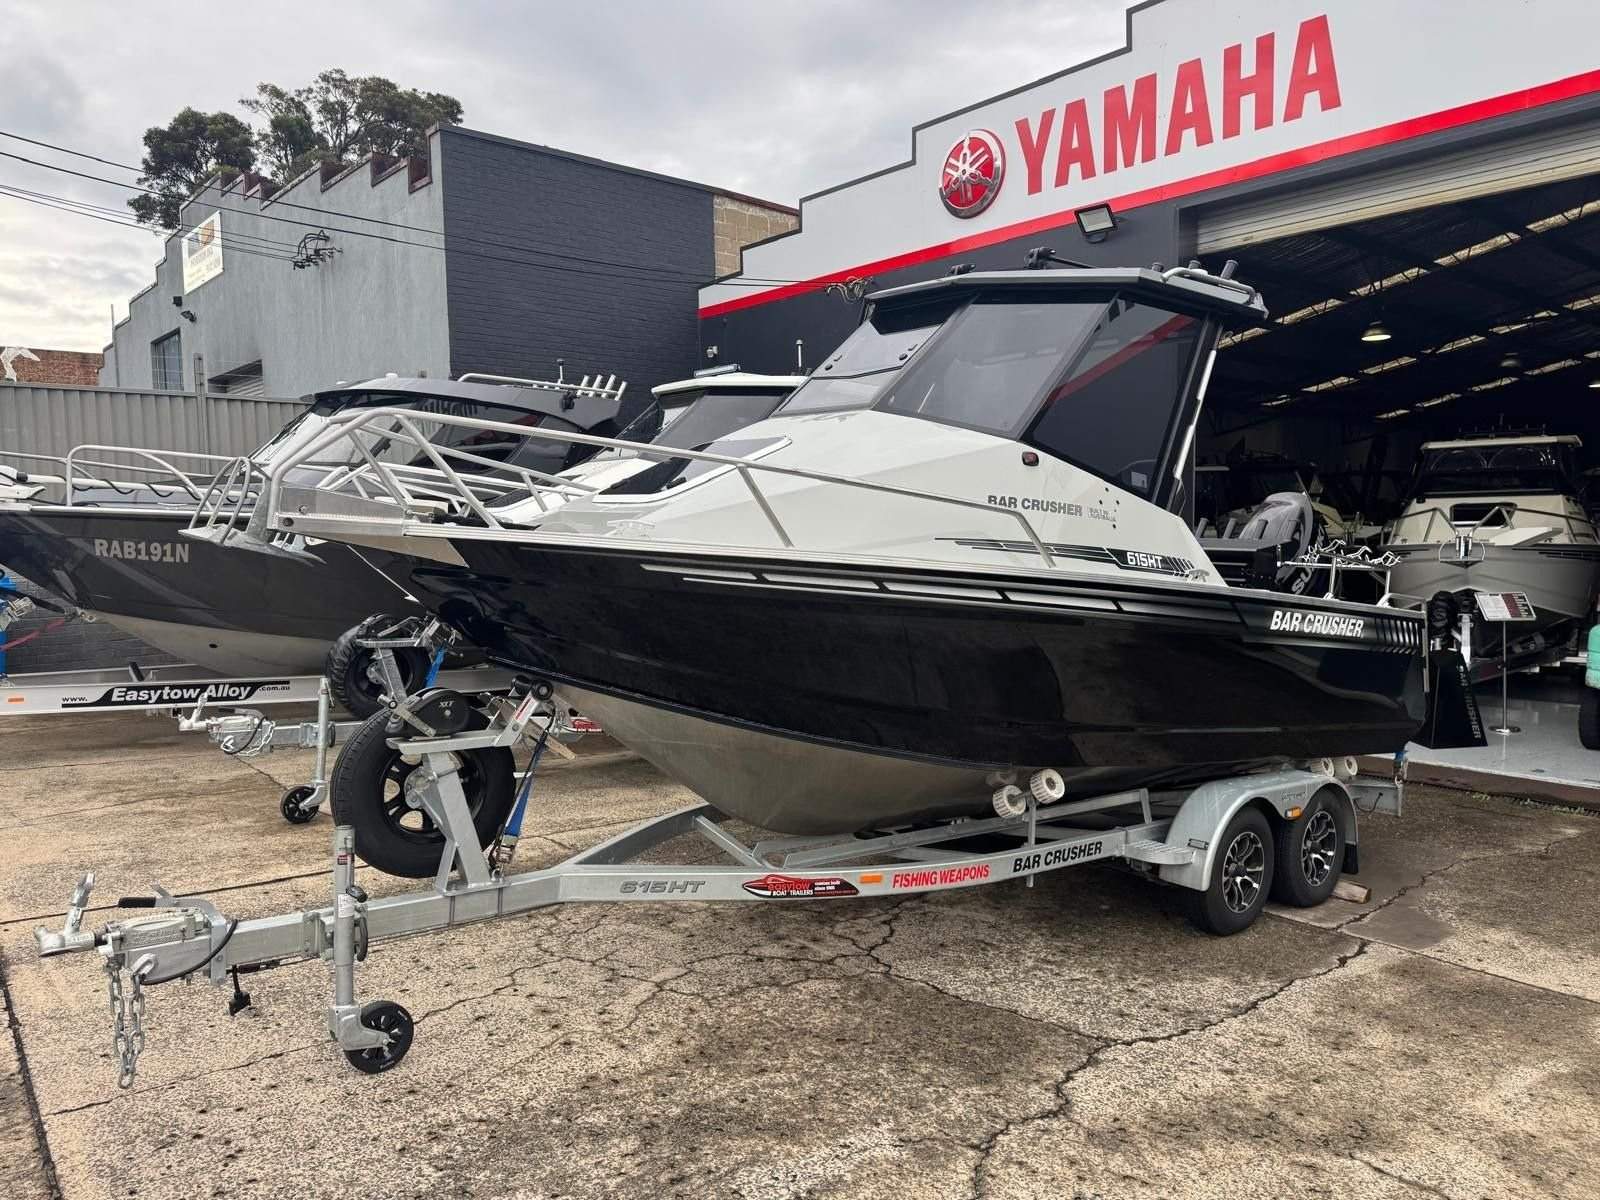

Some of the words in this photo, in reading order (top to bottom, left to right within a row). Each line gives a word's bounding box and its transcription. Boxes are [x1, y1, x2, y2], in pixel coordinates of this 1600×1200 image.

[1015, 14, 1341, 195] YAMAHA
[987, 495, 1017, 508] BAR
[1021, 498, 1082, 516] CRUSHER
[95, 539, 189, 562] RAB191N
[1127, 552, 1162, 568] 615HT
[1270, 610, 1301, 632] BAR
[1303, 613, 1364, 638] CRUSHER
[111, 685, 200, 704] Easytow
[206, 684, 251, 700] Alloy
[1013, 854, 1041, 873] BAR
[1044, 841, 1103, 867] CRUSHER
[620, 880, 705, 894] 615HT
[892, 870, 938, 889] FISHING
[939, 864, 990, 885] WEAPONS
[789, 888, 813, 896] TRAILERS
